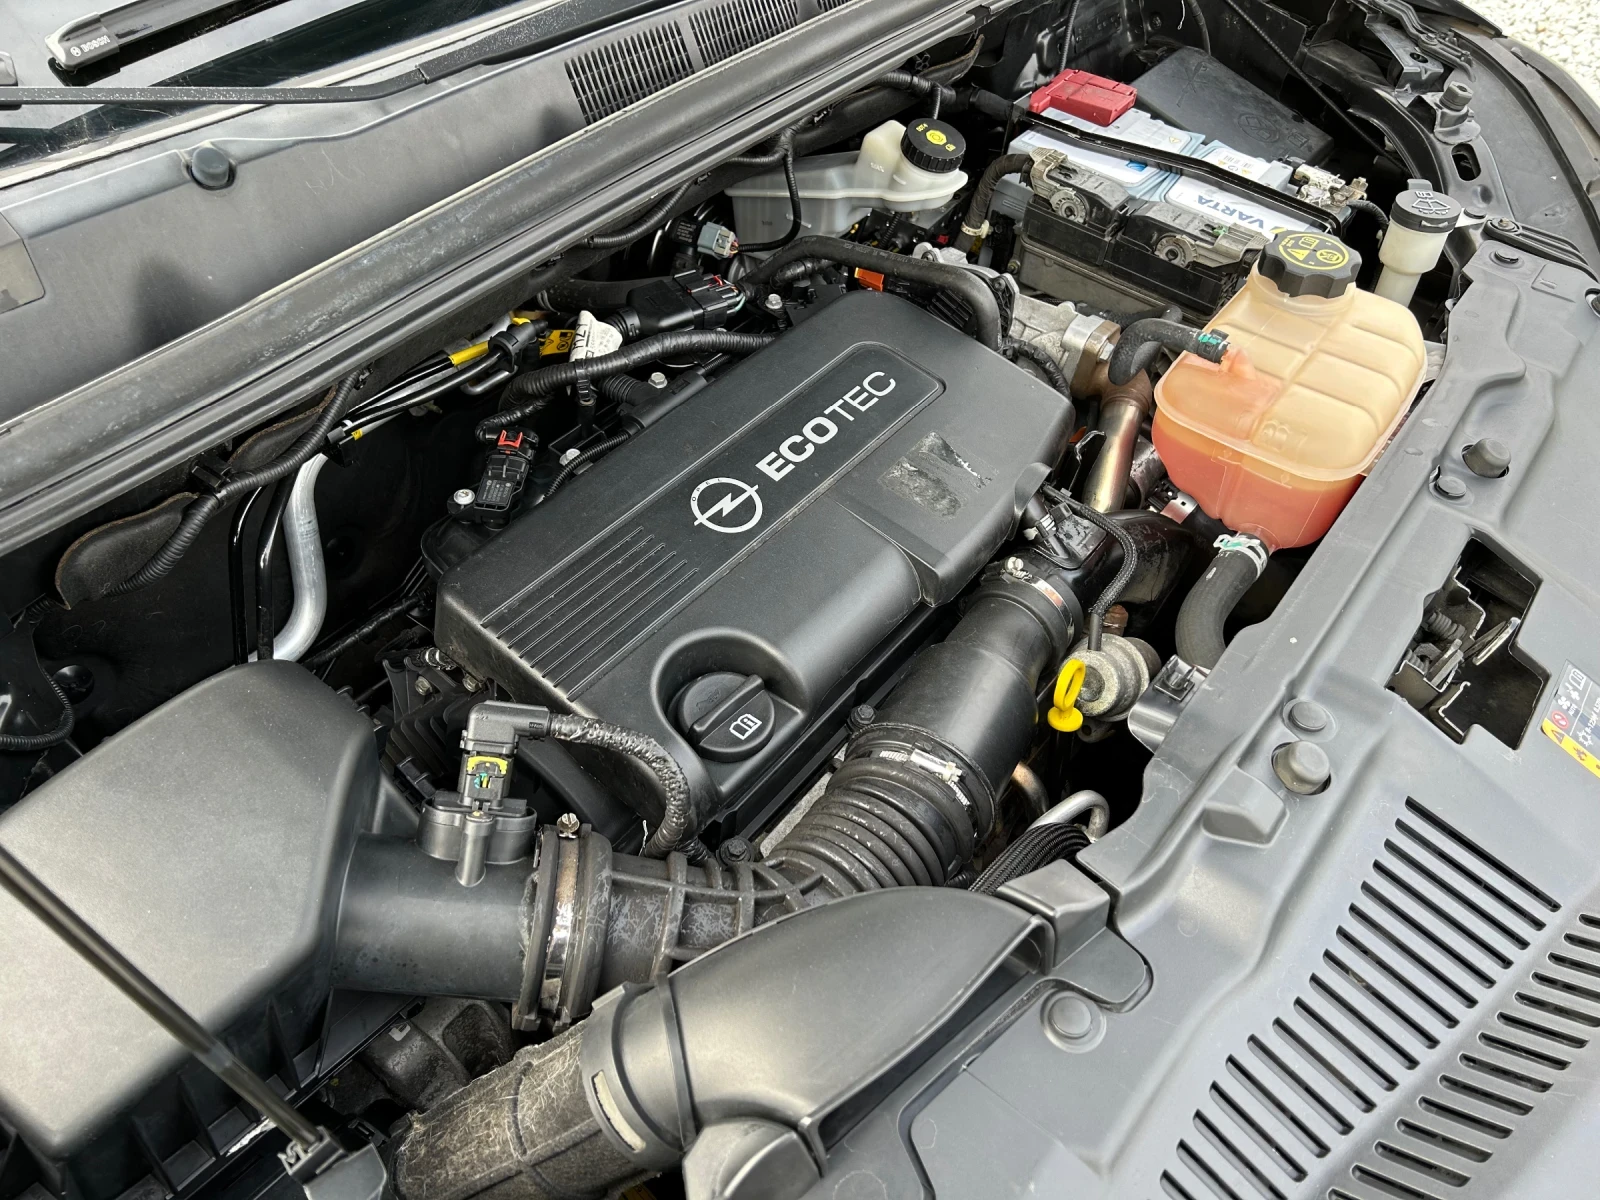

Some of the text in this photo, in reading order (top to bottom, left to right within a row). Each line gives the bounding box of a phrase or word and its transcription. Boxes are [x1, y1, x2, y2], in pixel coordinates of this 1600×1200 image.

[81, 35, 111, 52] BOSCH
[1198, 195, 1264, 229] VARTA
[755, 371, 896, 482] ECOTEC
[691, 478, 723, 502] OPEL
